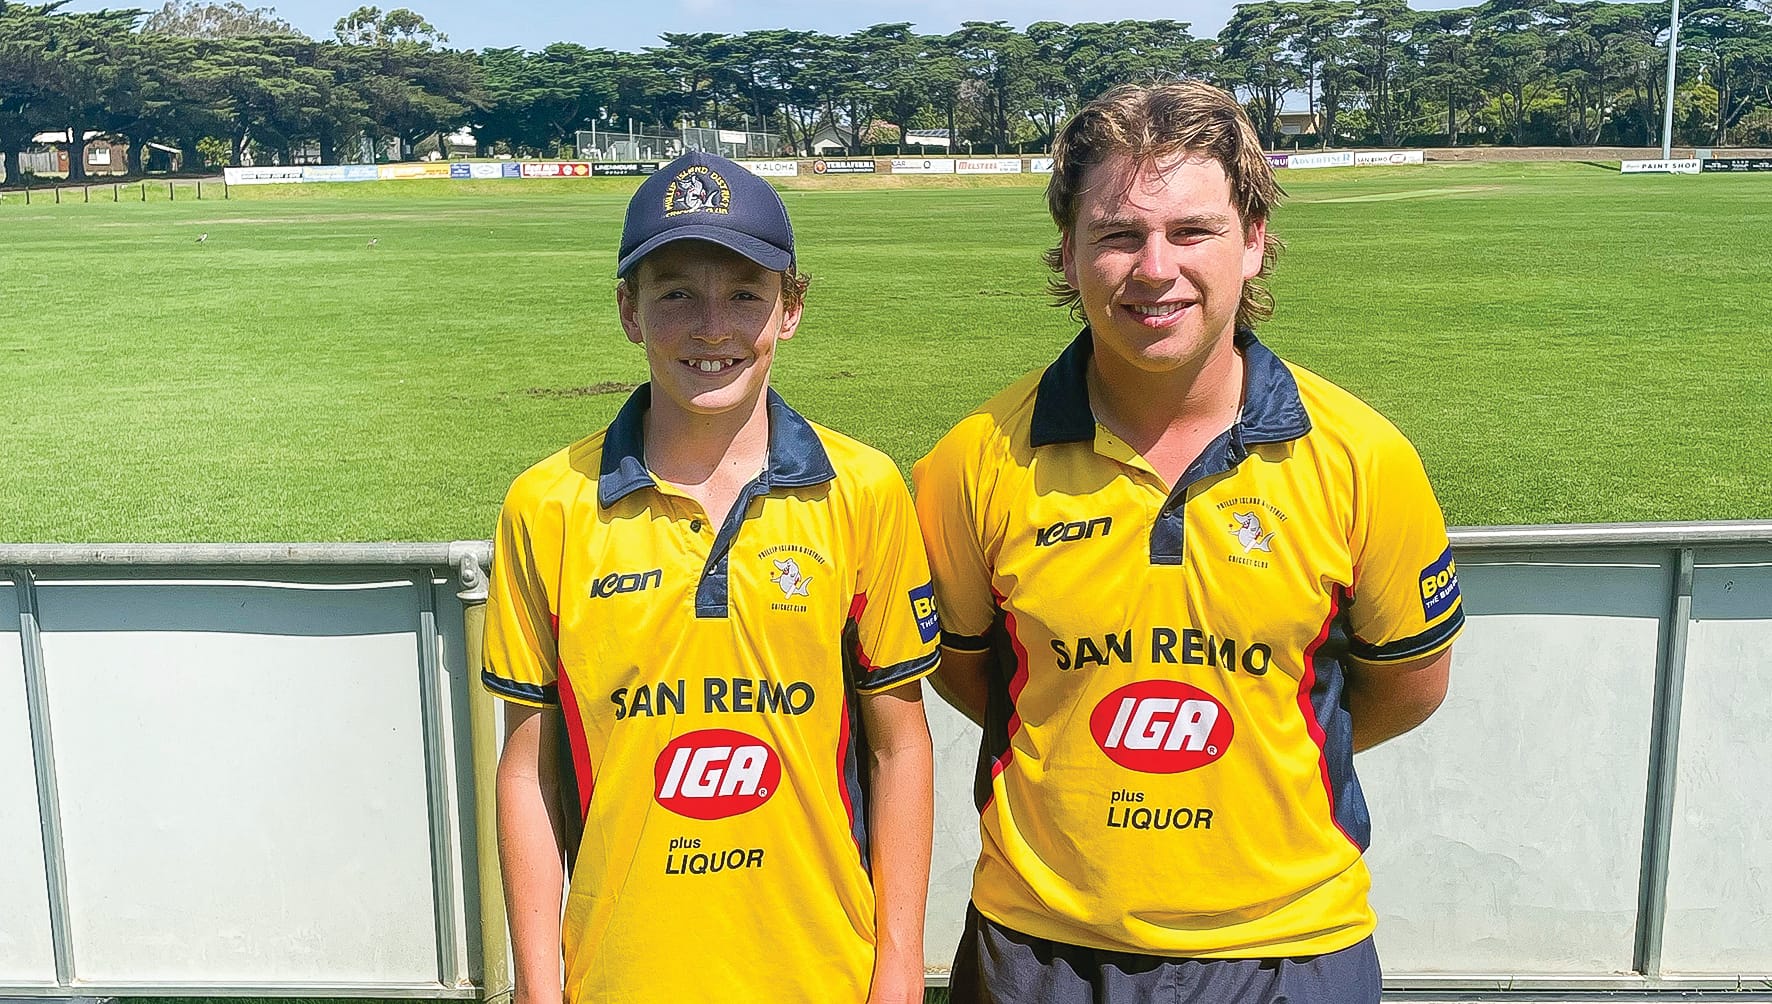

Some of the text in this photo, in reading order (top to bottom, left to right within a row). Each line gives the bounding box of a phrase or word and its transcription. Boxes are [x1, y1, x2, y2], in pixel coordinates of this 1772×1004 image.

[676, 166, 709, 180] ISLAND
[755, 163, 794, 171] KALOHA
[758, 546, 778, 560] PHILLIP
[778, 544, 798, 552] ISLAND
[803, 547, 826, 565] DISTRICT
[1228, 554, 1268, 569] CRICKET CLUB
[771, 602, 807, 613] CRICKET CLUB
[1425, 595, 1440, 609] THE
[1050, 627, 1273, 676] SAN REMO
[610, 677, 816, 721] SAN REMO
[1104, 697, 1219, 752] IGA
[658, 745, 769, 799] IGA
[1110, 788, 1145, 804] plus
[1106, 806, 1214, 831] LIQUOR
[668, 836, 702, 852] plus
[665, 848, 765, 876] LIQUOR
